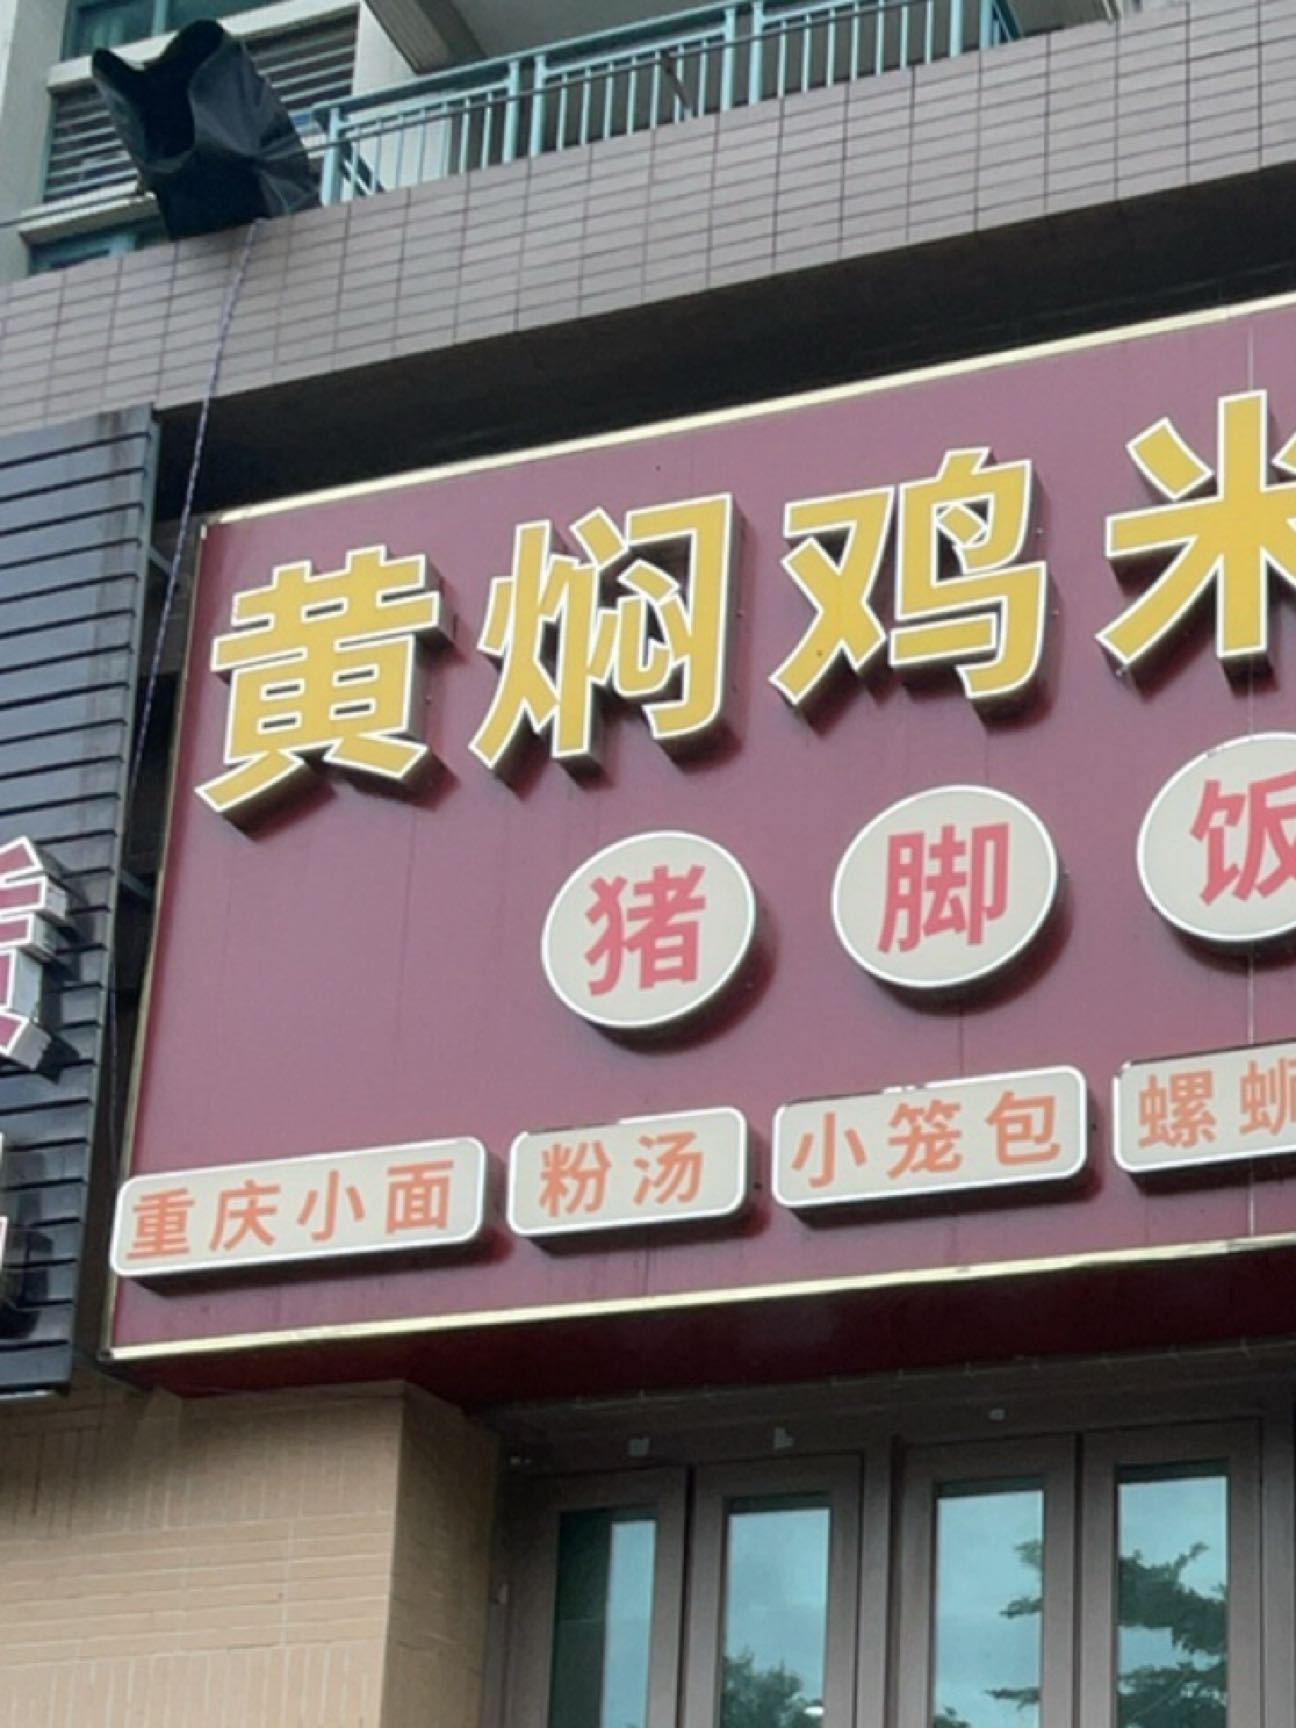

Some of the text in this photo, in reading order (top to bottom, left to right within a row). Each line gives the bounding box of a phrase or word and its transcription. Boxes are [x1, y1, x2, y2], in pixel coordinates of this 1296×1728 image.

[126, 1160, 454, 1260] 重庆小面
[538, 1132, 705, 1217] 粉汤
[792, 1091, 1061, 1189] 小笼包
